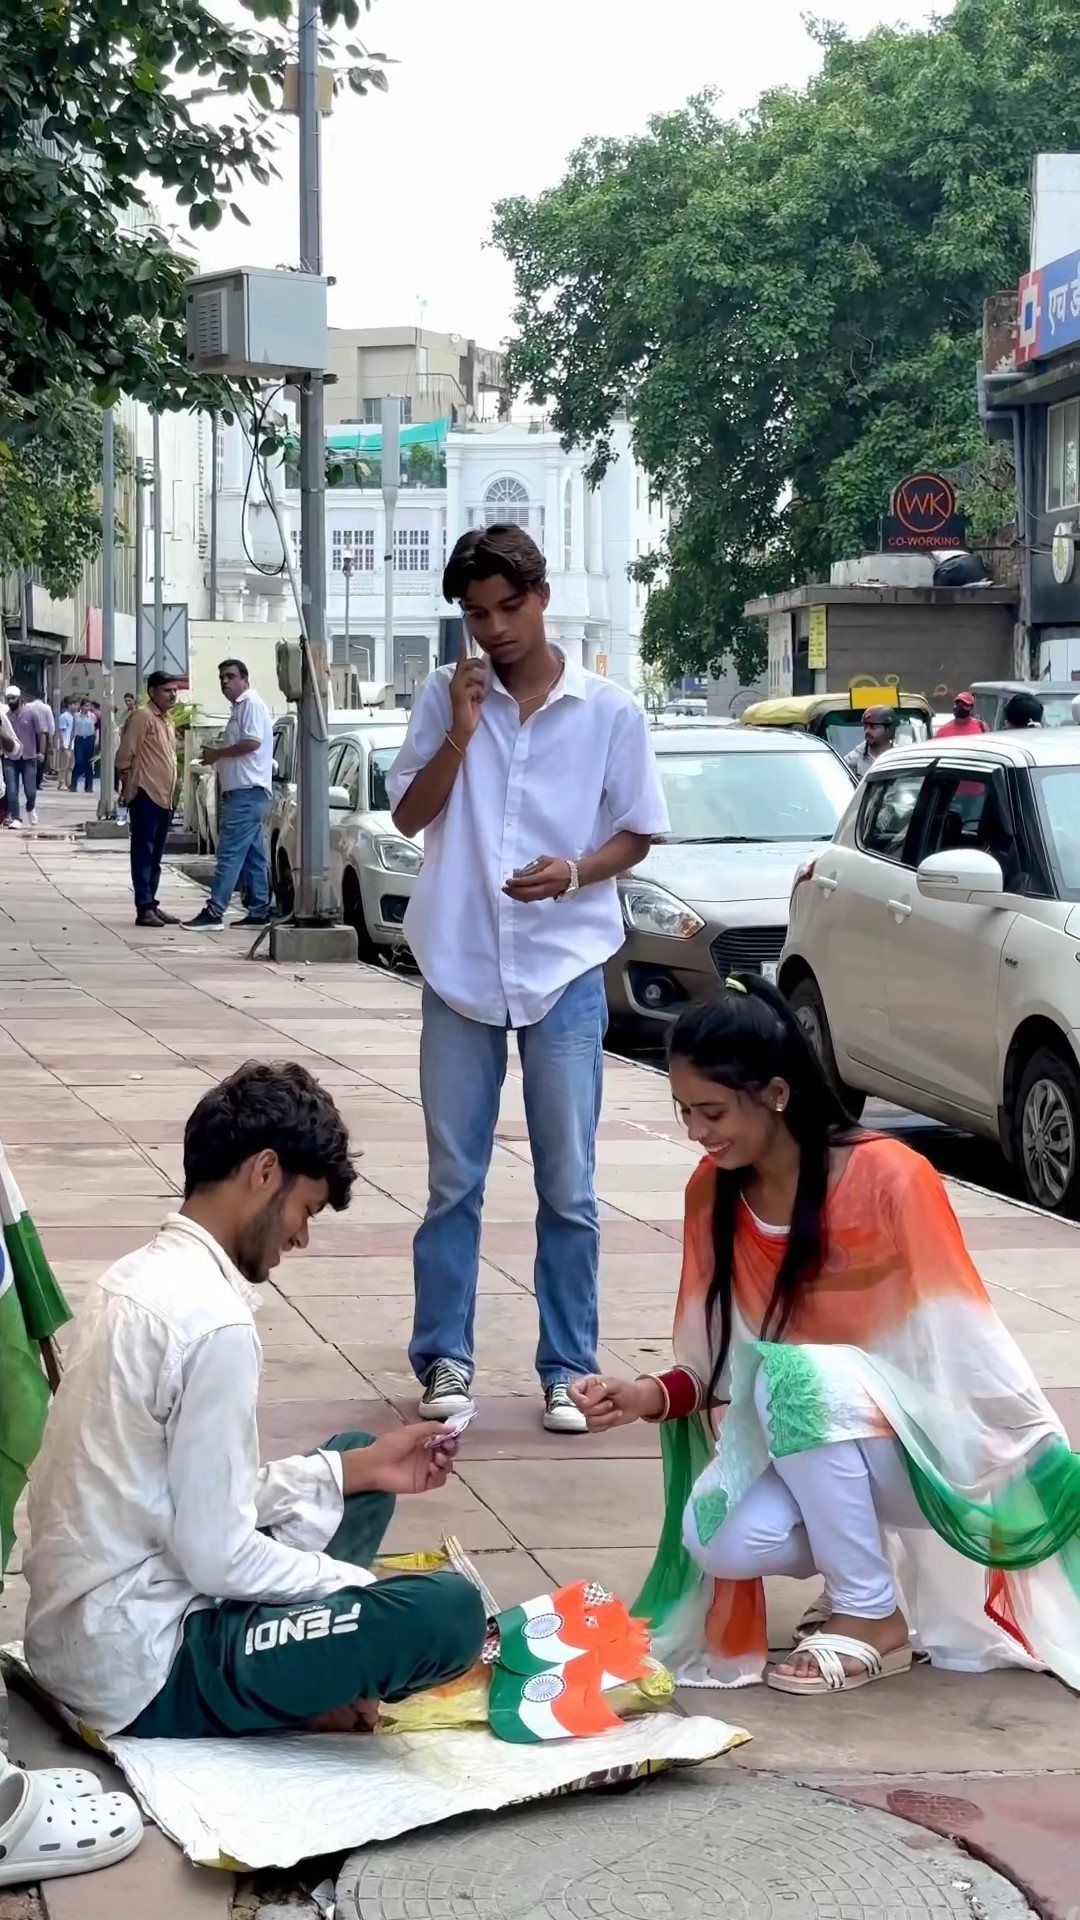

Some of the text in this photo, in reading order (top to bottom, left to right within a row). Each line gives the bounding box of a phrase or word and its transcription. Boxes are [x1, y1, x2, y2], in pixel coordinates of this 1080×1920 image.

[901, 486, 949, 519] WK
[888, 536, 960, 546] CO-WORKING
[245, 1602, 361, 1655] FENDI
